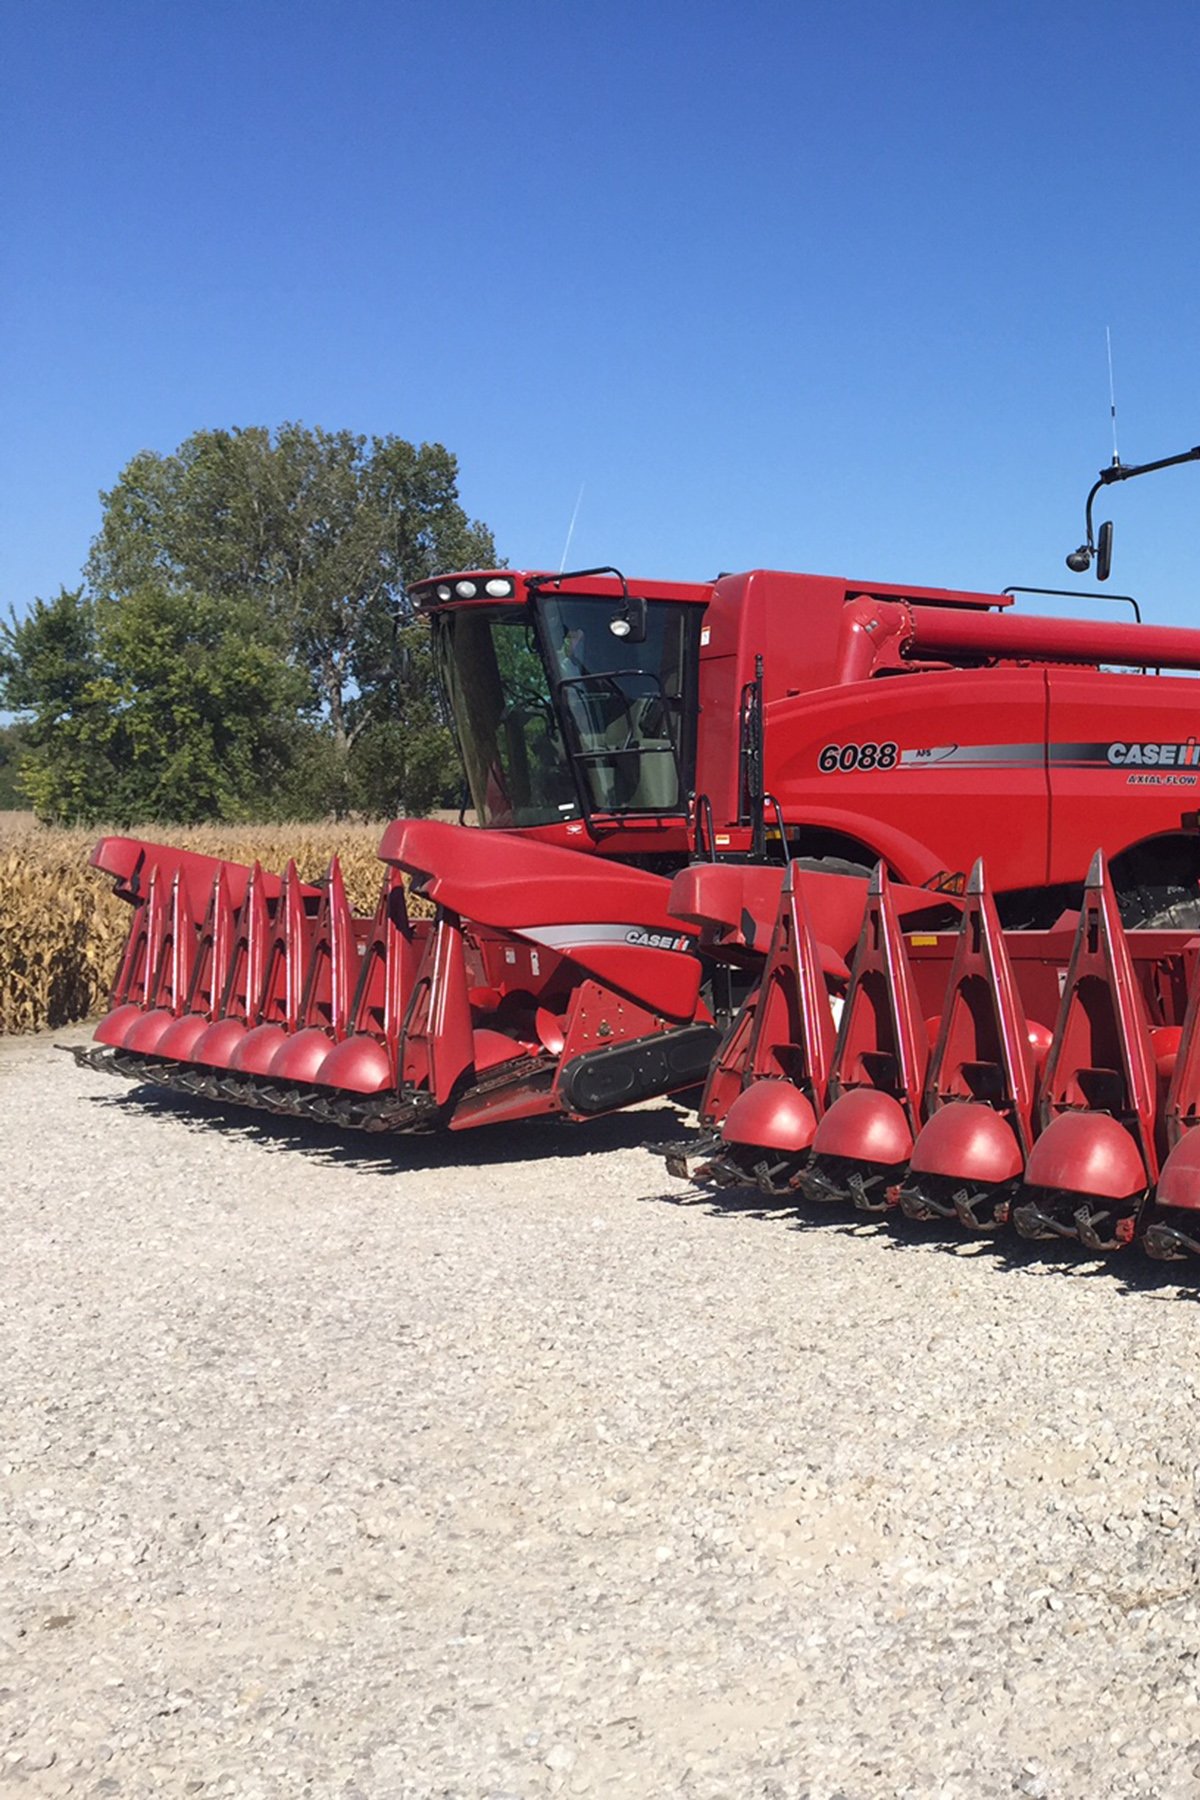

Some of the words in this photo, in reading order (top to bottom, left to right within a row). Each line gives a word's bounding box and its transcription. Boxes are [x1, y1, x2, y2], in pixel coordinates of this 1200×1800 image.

[818, 742, 898, 773] 6088
[1107, 741, 1176, 766] CASE
[1126, 774, 1198, 786] AXIAL-FLOW
[626, 930, 672, 949] CASE
